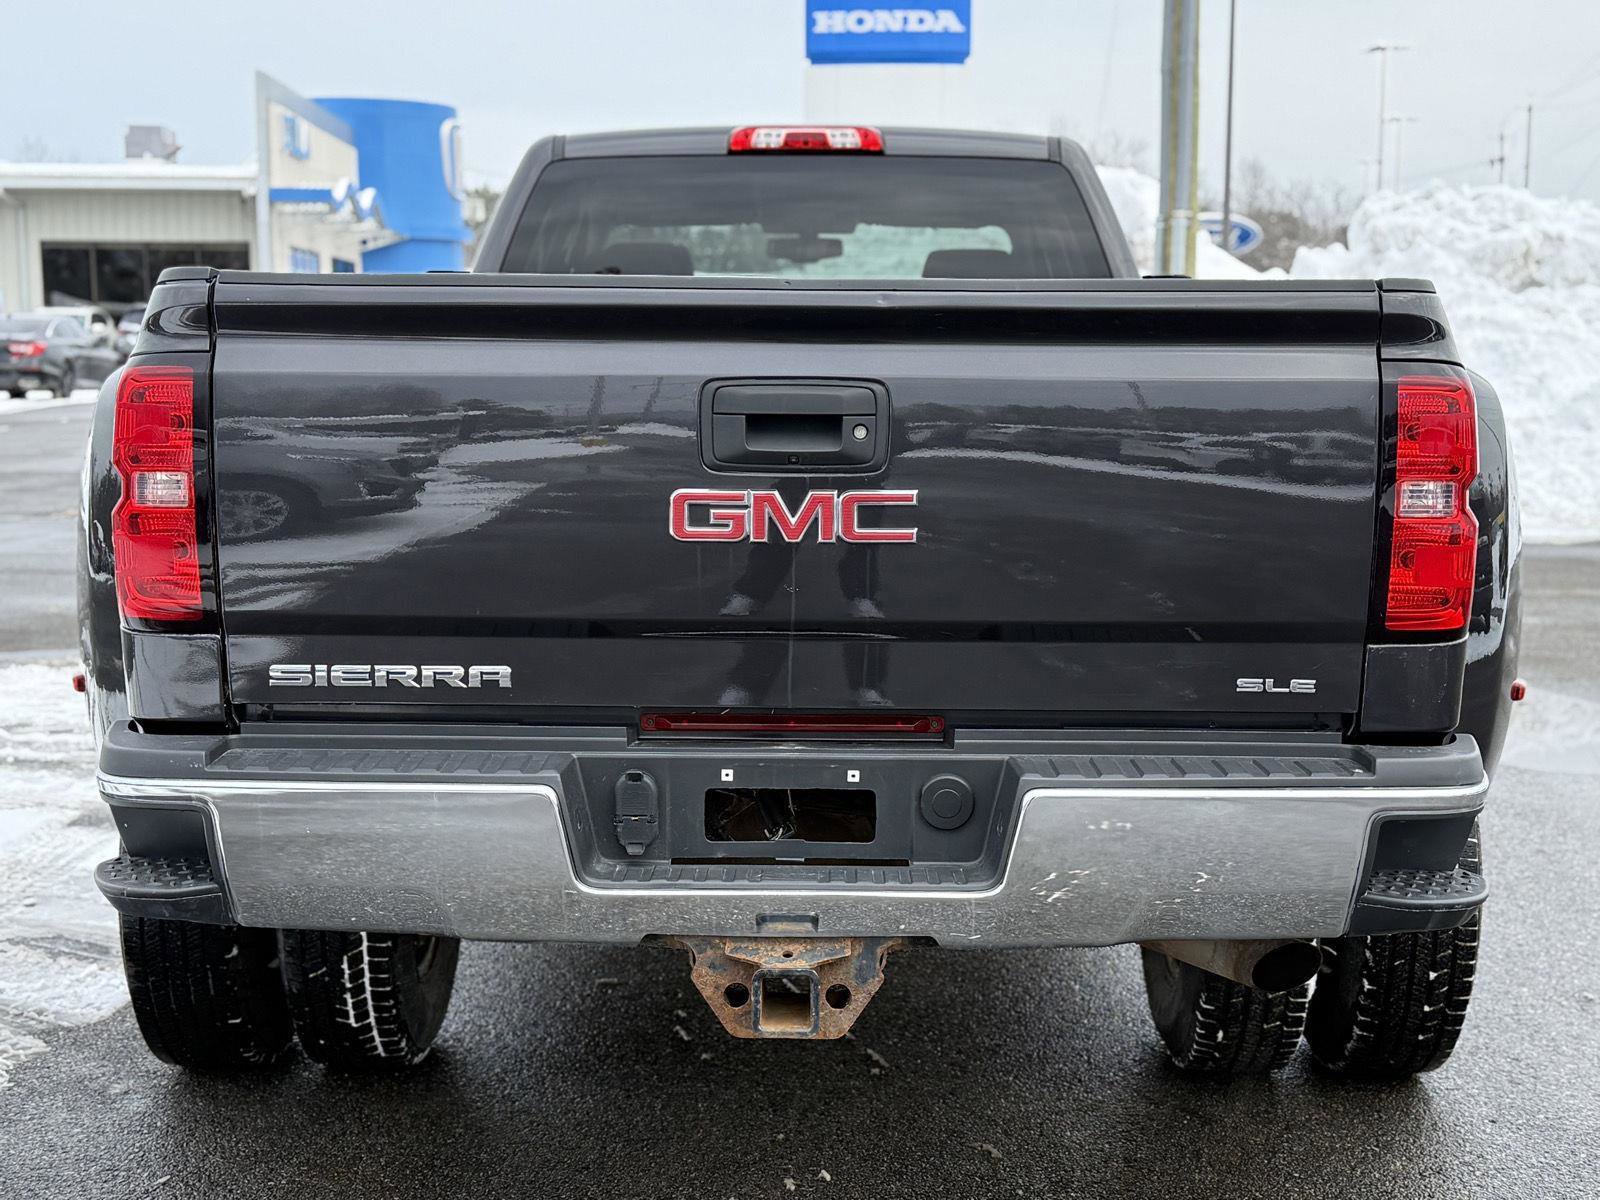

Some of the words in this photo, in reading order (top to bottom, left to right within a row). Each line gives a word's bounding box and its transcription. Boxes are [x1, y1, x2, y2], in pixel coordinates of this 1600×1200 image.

[812, 10, 964, 33] HONDA
[669, 489, 918, 543] GMC
[269, 664, 512, 688] SIERRA
[1236, 678, 1317, 693] SLE
